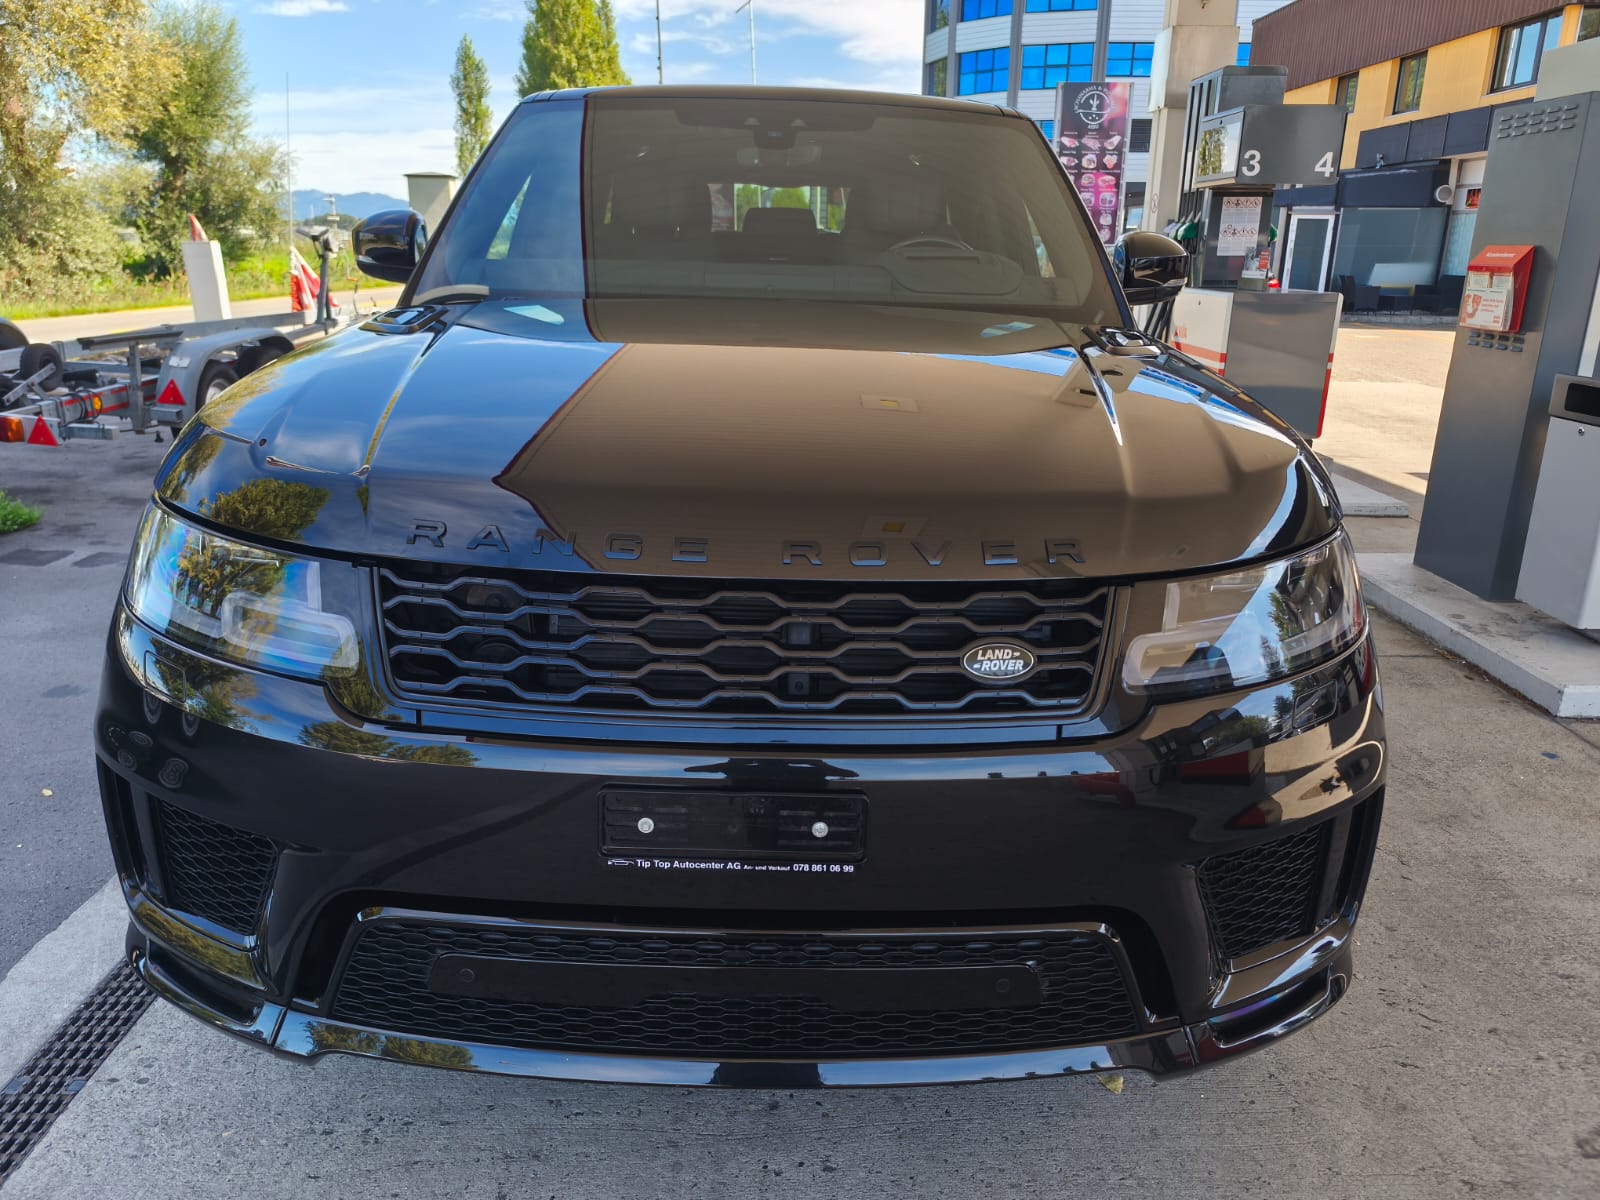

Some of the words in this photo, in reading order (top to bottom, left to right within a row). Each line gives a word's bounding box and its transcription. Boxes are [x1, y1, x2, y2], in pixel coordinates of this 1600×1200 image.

[1241, 150, 1261, 177] 3
[1314, 152, 1334, 177] 4
[406, 518, 709, 562] RANGE
[782, 538, 1086, 566] ROVER
[977, 649, 1012, 660] LAND
[981, 660, 1024, 671] ROVER
[636, 859, 651, 869] Tip
[653, 860, 671, 869] Top
[673, 860, 724, 869] Autocenter
[726, 862, 741, 870] AG
[793, 863, 809, 872] 078
[811, 864, 827, 872] 861
[829, 864, 841, 872] 06
[843, 865, 854, 873] 99
